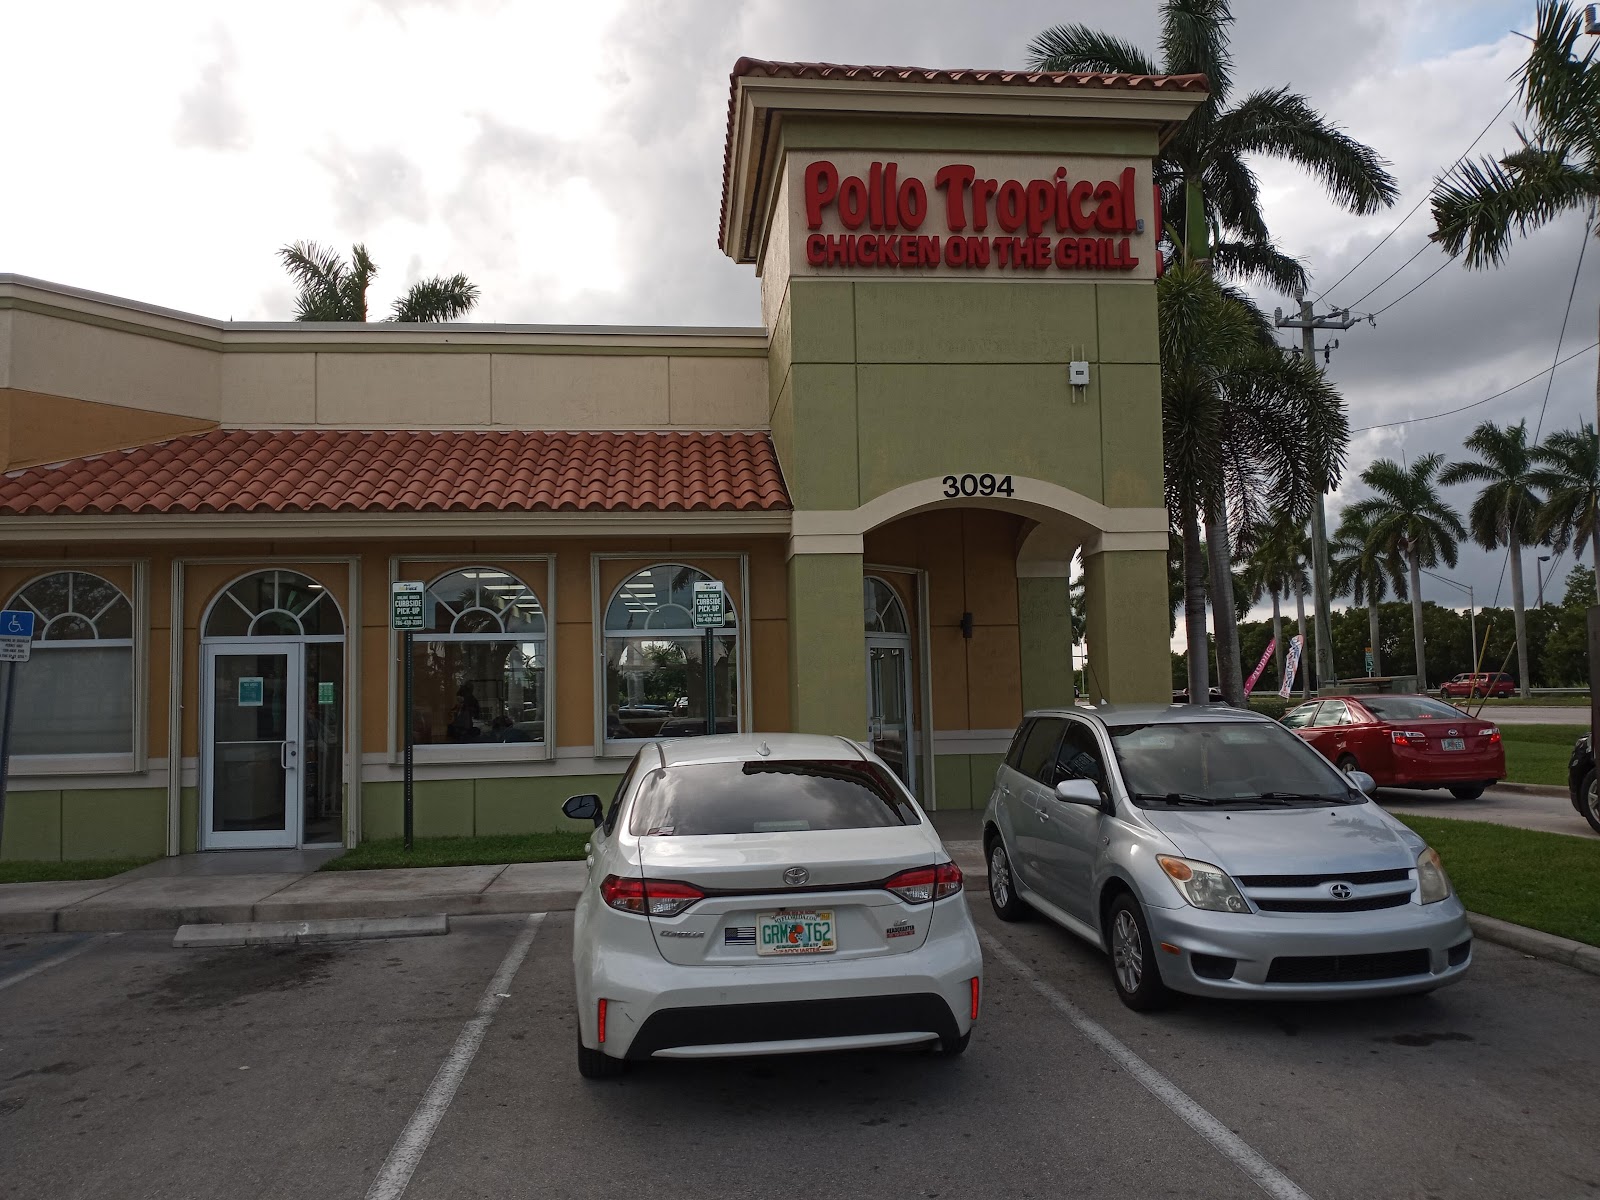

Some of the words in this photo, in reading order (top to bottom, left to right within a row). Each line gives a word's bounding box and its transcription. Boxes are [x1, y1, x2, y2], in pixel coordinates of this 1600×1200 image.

[804, 160, 927, 231] Pollo
[935, 163, 1137, 237] Tropical
[806, 234, 940, 268] CHICKEN
[945, 235, 990, 269] ON
[993, 236, 1051, 270] THE
[1055, 237, 1139, 270] GRILL
[942, 473, 1015, 498] 3094
[396, 607, 420, 615] PICK-UP
[762, 924, 788, 944] GRM
[805, 921, 831, 942] T62
